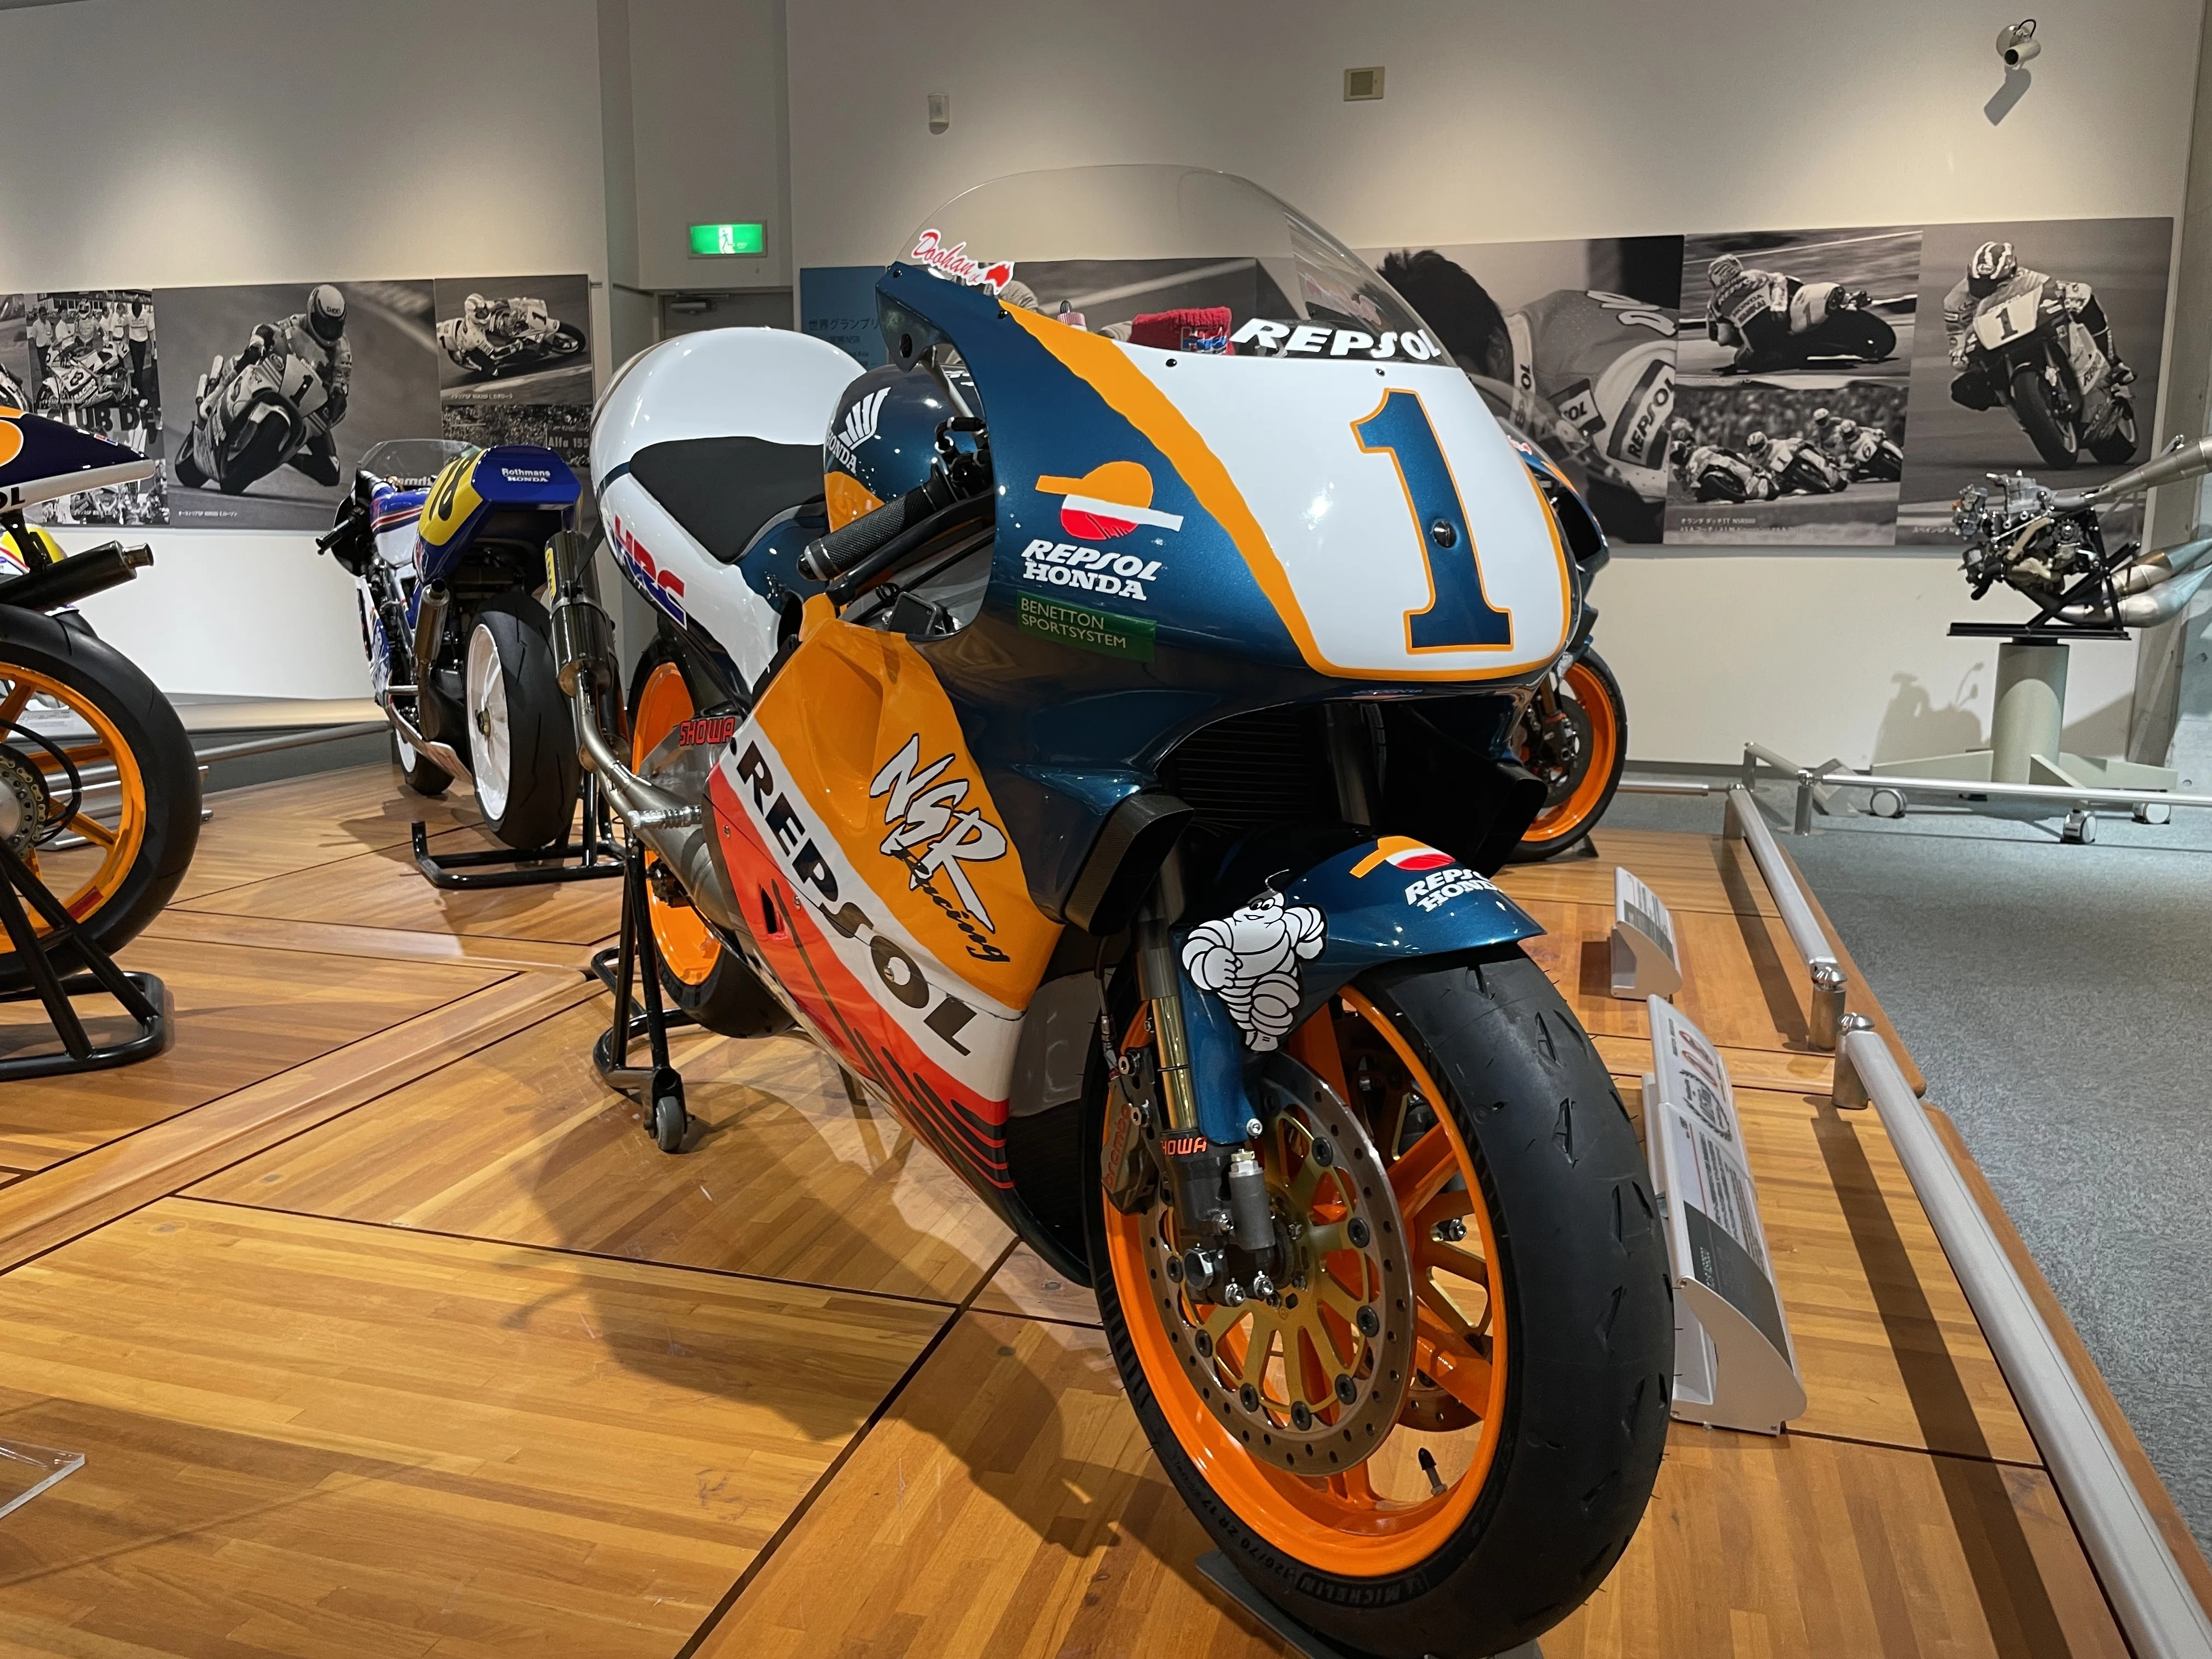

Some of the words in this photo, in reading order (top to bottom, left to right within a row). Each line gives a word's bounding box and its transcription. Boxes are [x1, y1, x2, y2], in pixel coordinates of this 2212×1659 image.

[913, 232, 976, 276] Doohan
[1229, 318, 1441, 360] REPSOL
[1996, 308, 2018, 341] 1
[290, 375, 314, 408] 1
[501, 467, 551, 478] Rothmans
[826, 432, 857, 475] HONDA
[1350, 388, 1514, 654] 1
[614, 514, 689, 631] HRC
[1021, 539, 1162, 582] REPSOL
[1023, 561, 1147, 601] HONDA
[1020, 598, 1104, 630] BENETTON
[1021, 613, 1126, 648] SPORTSYSTEM
[680, 716, 736, 747] SHOWA
[869, 732, 1008, 934] NSR
[736, 740, 978, 1056] REPSOL
[890, 838, 1011, 963] Racing
[1404, 868, 1491, 906] REPS
[1417, 879, 1504, 913] HOND
[1102, 1103, 1132, 1189] brembo
[1160, 1136, 1207, 1156] HOWA
